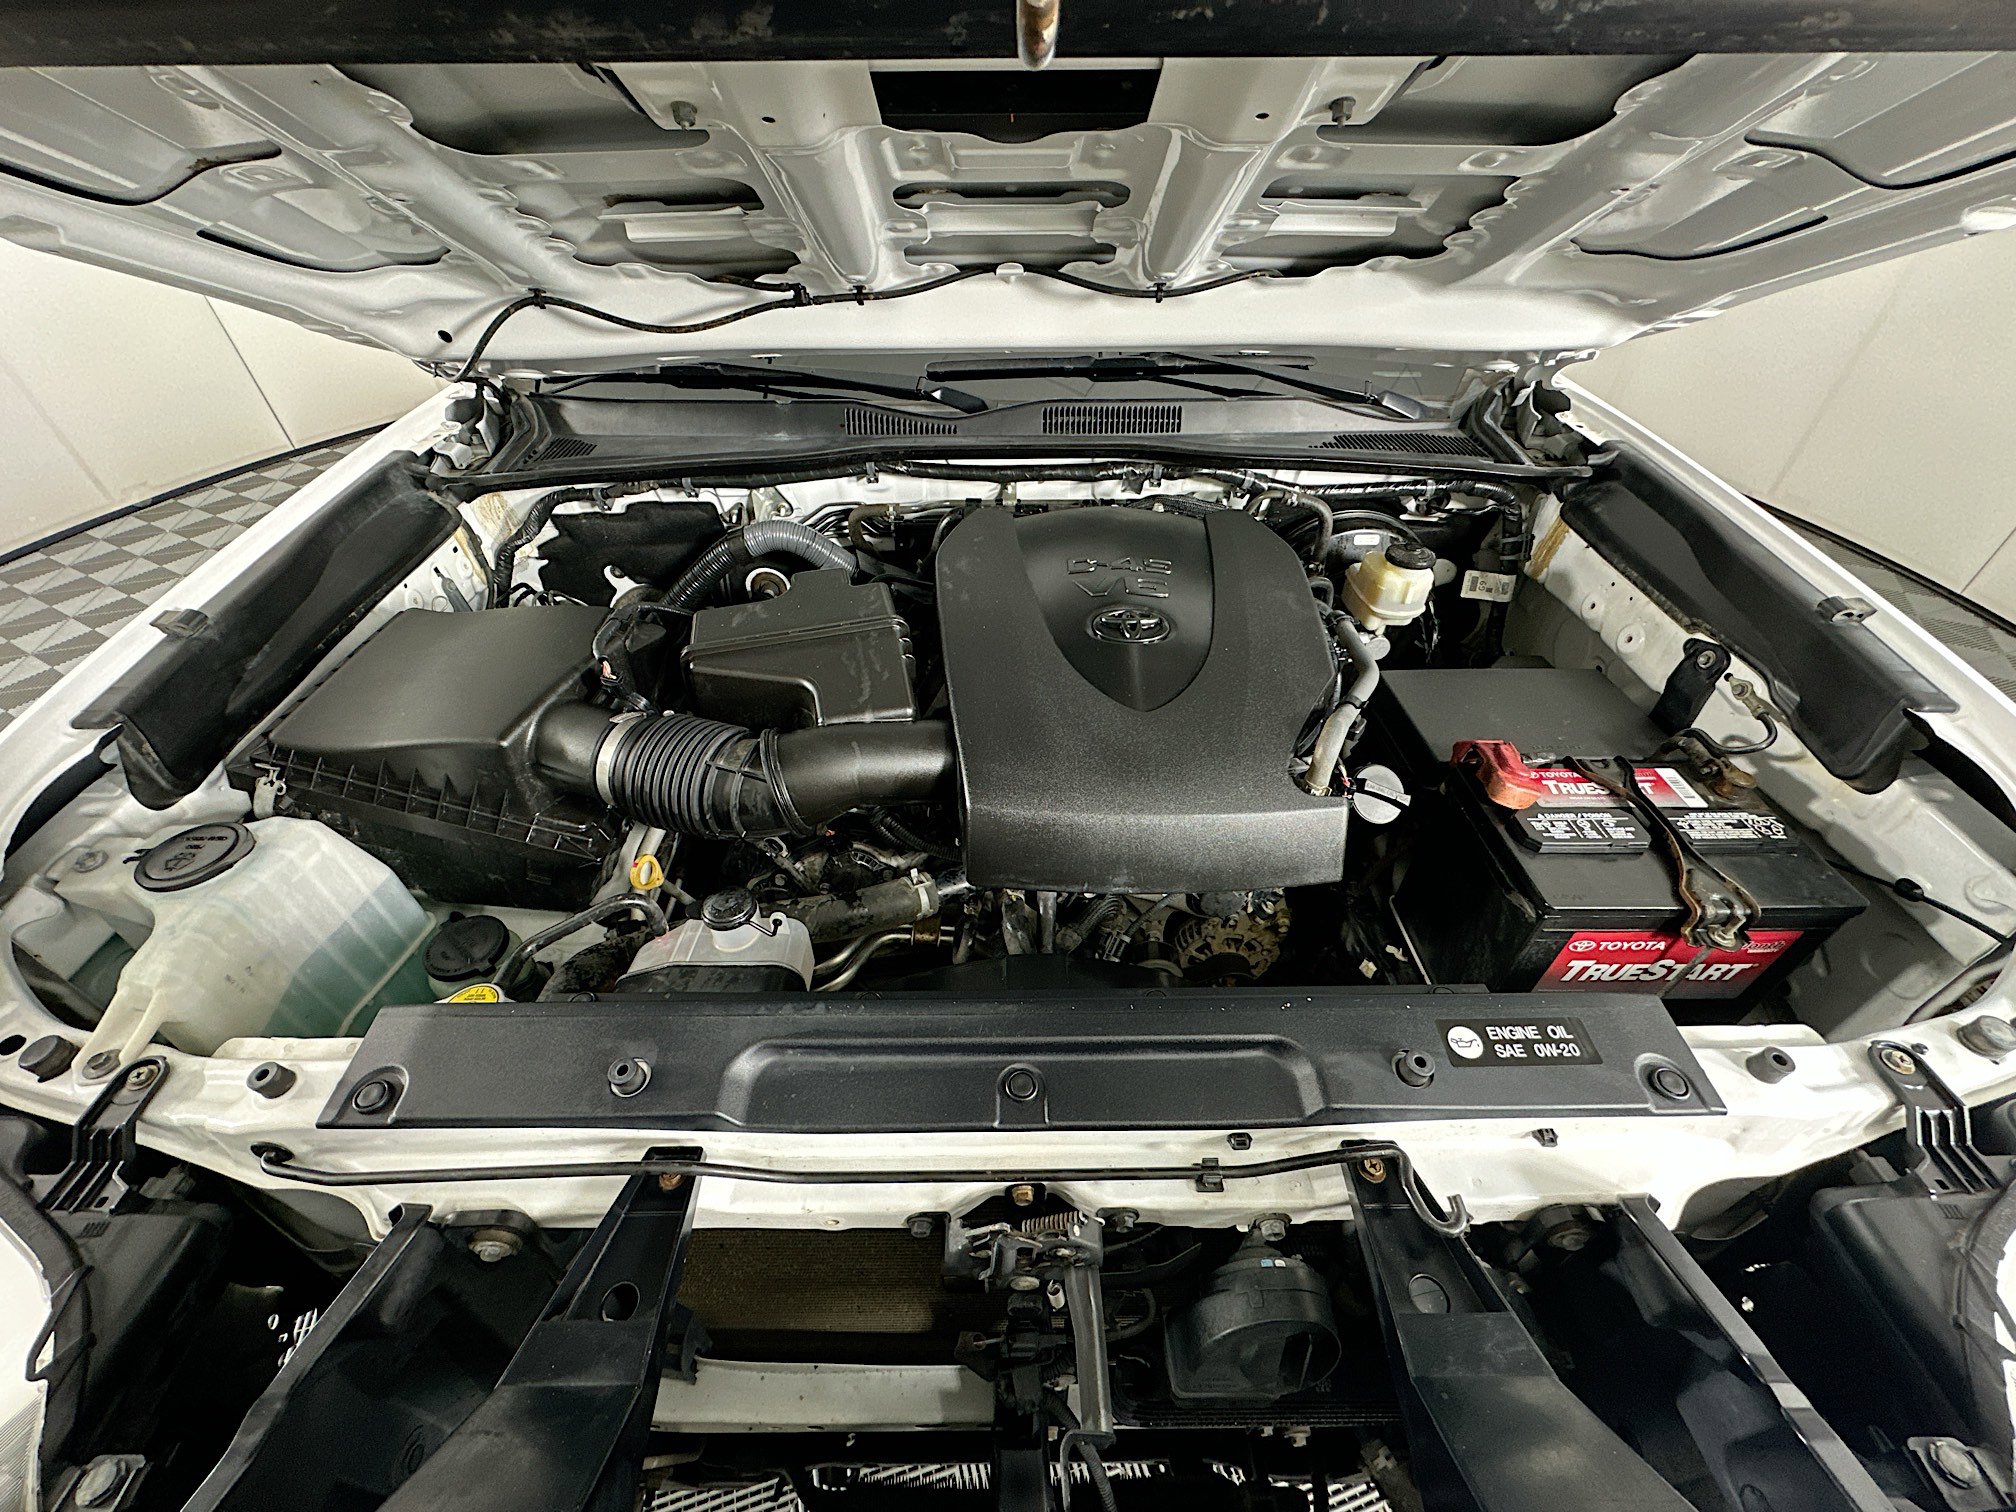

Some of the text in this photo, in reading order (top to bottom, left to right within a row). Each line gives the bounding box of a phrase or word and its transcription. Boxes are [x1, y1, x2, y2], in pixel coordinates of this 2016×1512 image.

[1072, 578, 1169, 598] V6
[1538, 771, 1582, 779] TOYOTA
[1599, 940, 1666, 951] TOYOTA
[1485, 1025, 1573, 1040] ENGINE OIL
[1494, 1043, 1581, 1058] SAE 0W-20
